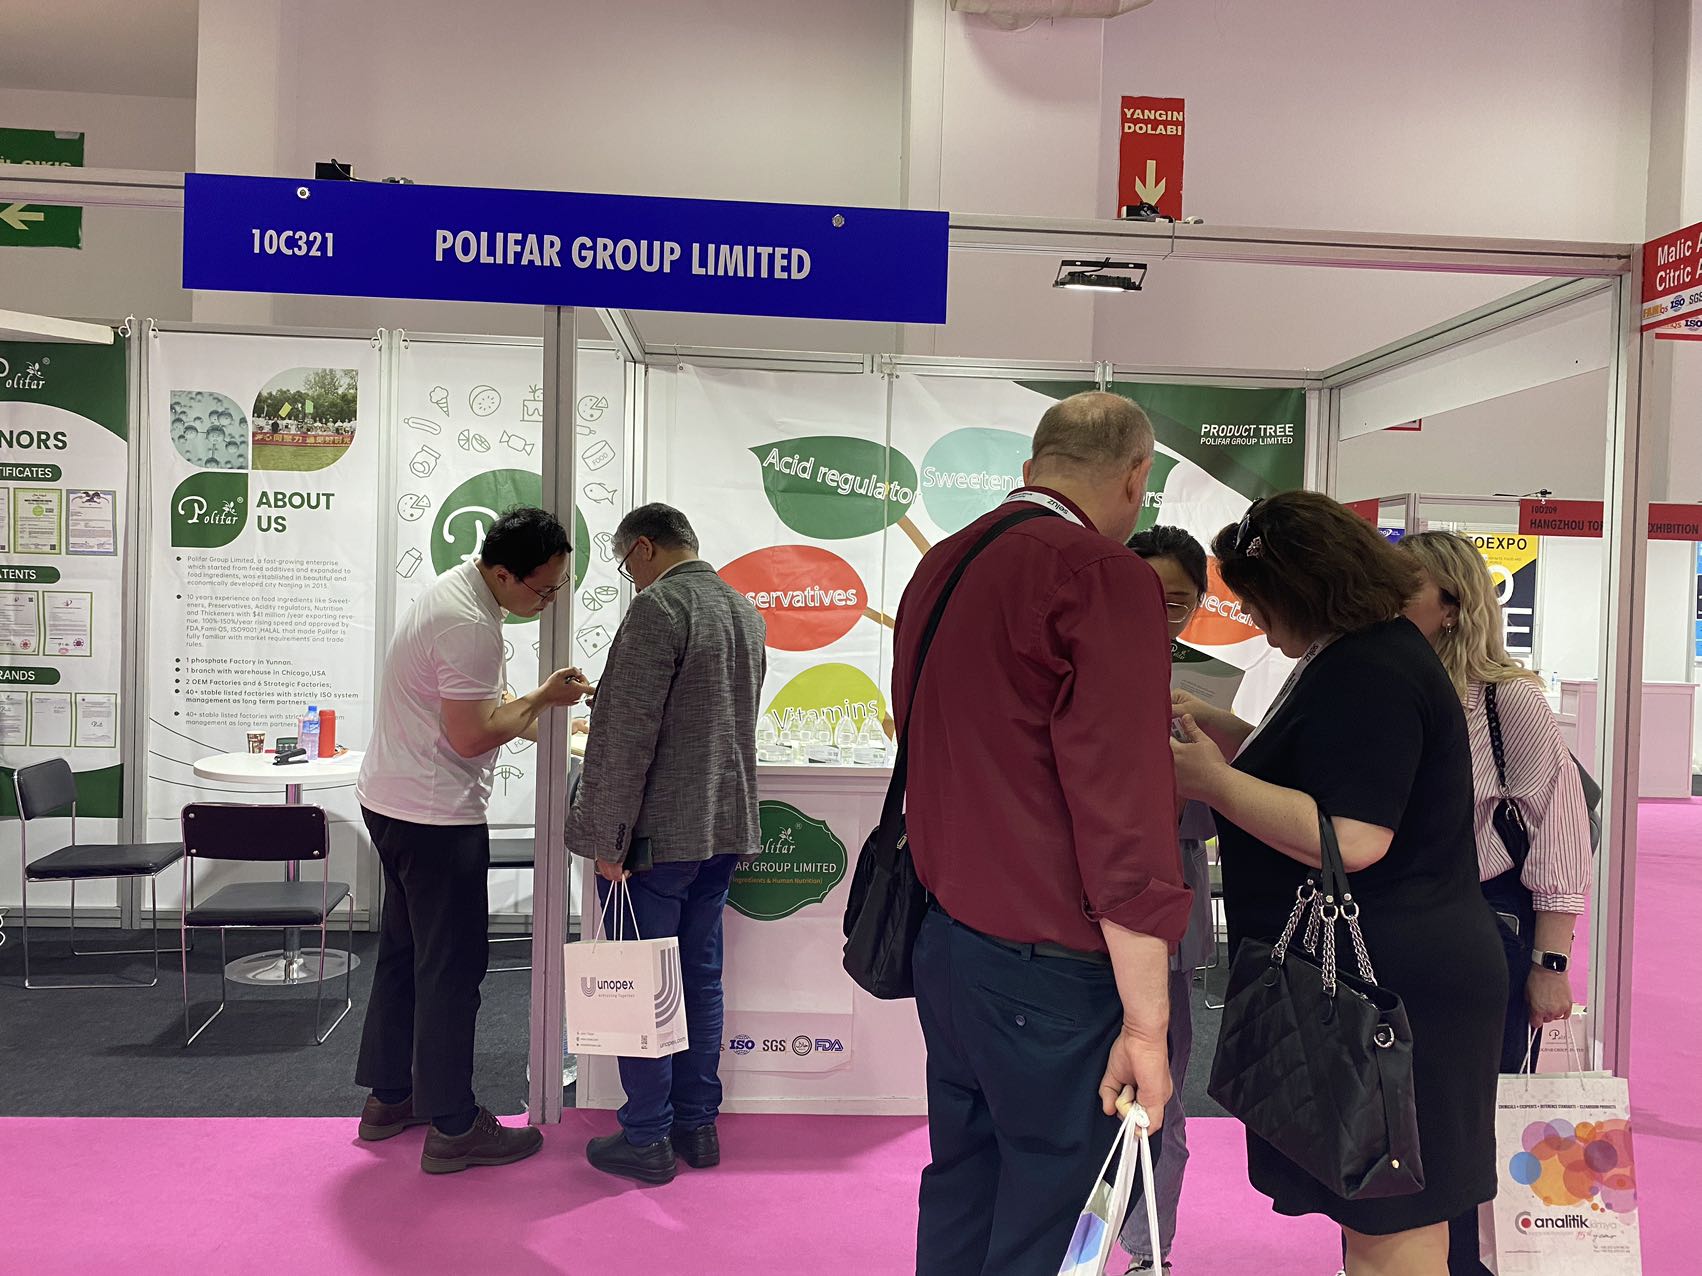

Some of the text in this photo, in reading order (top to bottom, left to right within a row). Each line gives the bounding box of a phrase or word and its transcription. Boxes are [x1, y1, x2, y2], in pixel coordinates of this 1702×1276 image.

[1123, 108, 1184, 122] YANGIN
[1124, 122, 1182, 136] DOLABI
[251, 228, 812, 280] 10C321 POLIFAR GROUP LIMITED
[1657, 238, 1692, 266] Malic
[1656, 264, 1691, 292] Citric
[1200, 423, 1294, 437] PRODUCT TREE
[1200, 436, 1294, 446] POLIFAR GROUP LIMITED
[592, 452, 608, 465] FOOD
[763, 447, 921, 505] Acid regulator
[922, 466, 1025, 492] Sweetene
[256, 490, 335, 510] ABOUT
[177, 495, 239, 525] Polifar
[257, 515, 287, 533] US
[1530, 518, 1585, 531] HANGZHOU
[744, 585, 858, 608] servatives
[771, 698, 879, 730] Vitamins
[752, 862, 791, 873] GROUP
[793, 863, 837, 873] LIMITED
[597, 979, 634, 992] unopex
[729, 1039, 755, 1050] ISO
[762, 1039, 786, 1052] SGS
[815, 1038, 844, 1052] FDA
[1534, 1214, 1590, 1229] analitik
